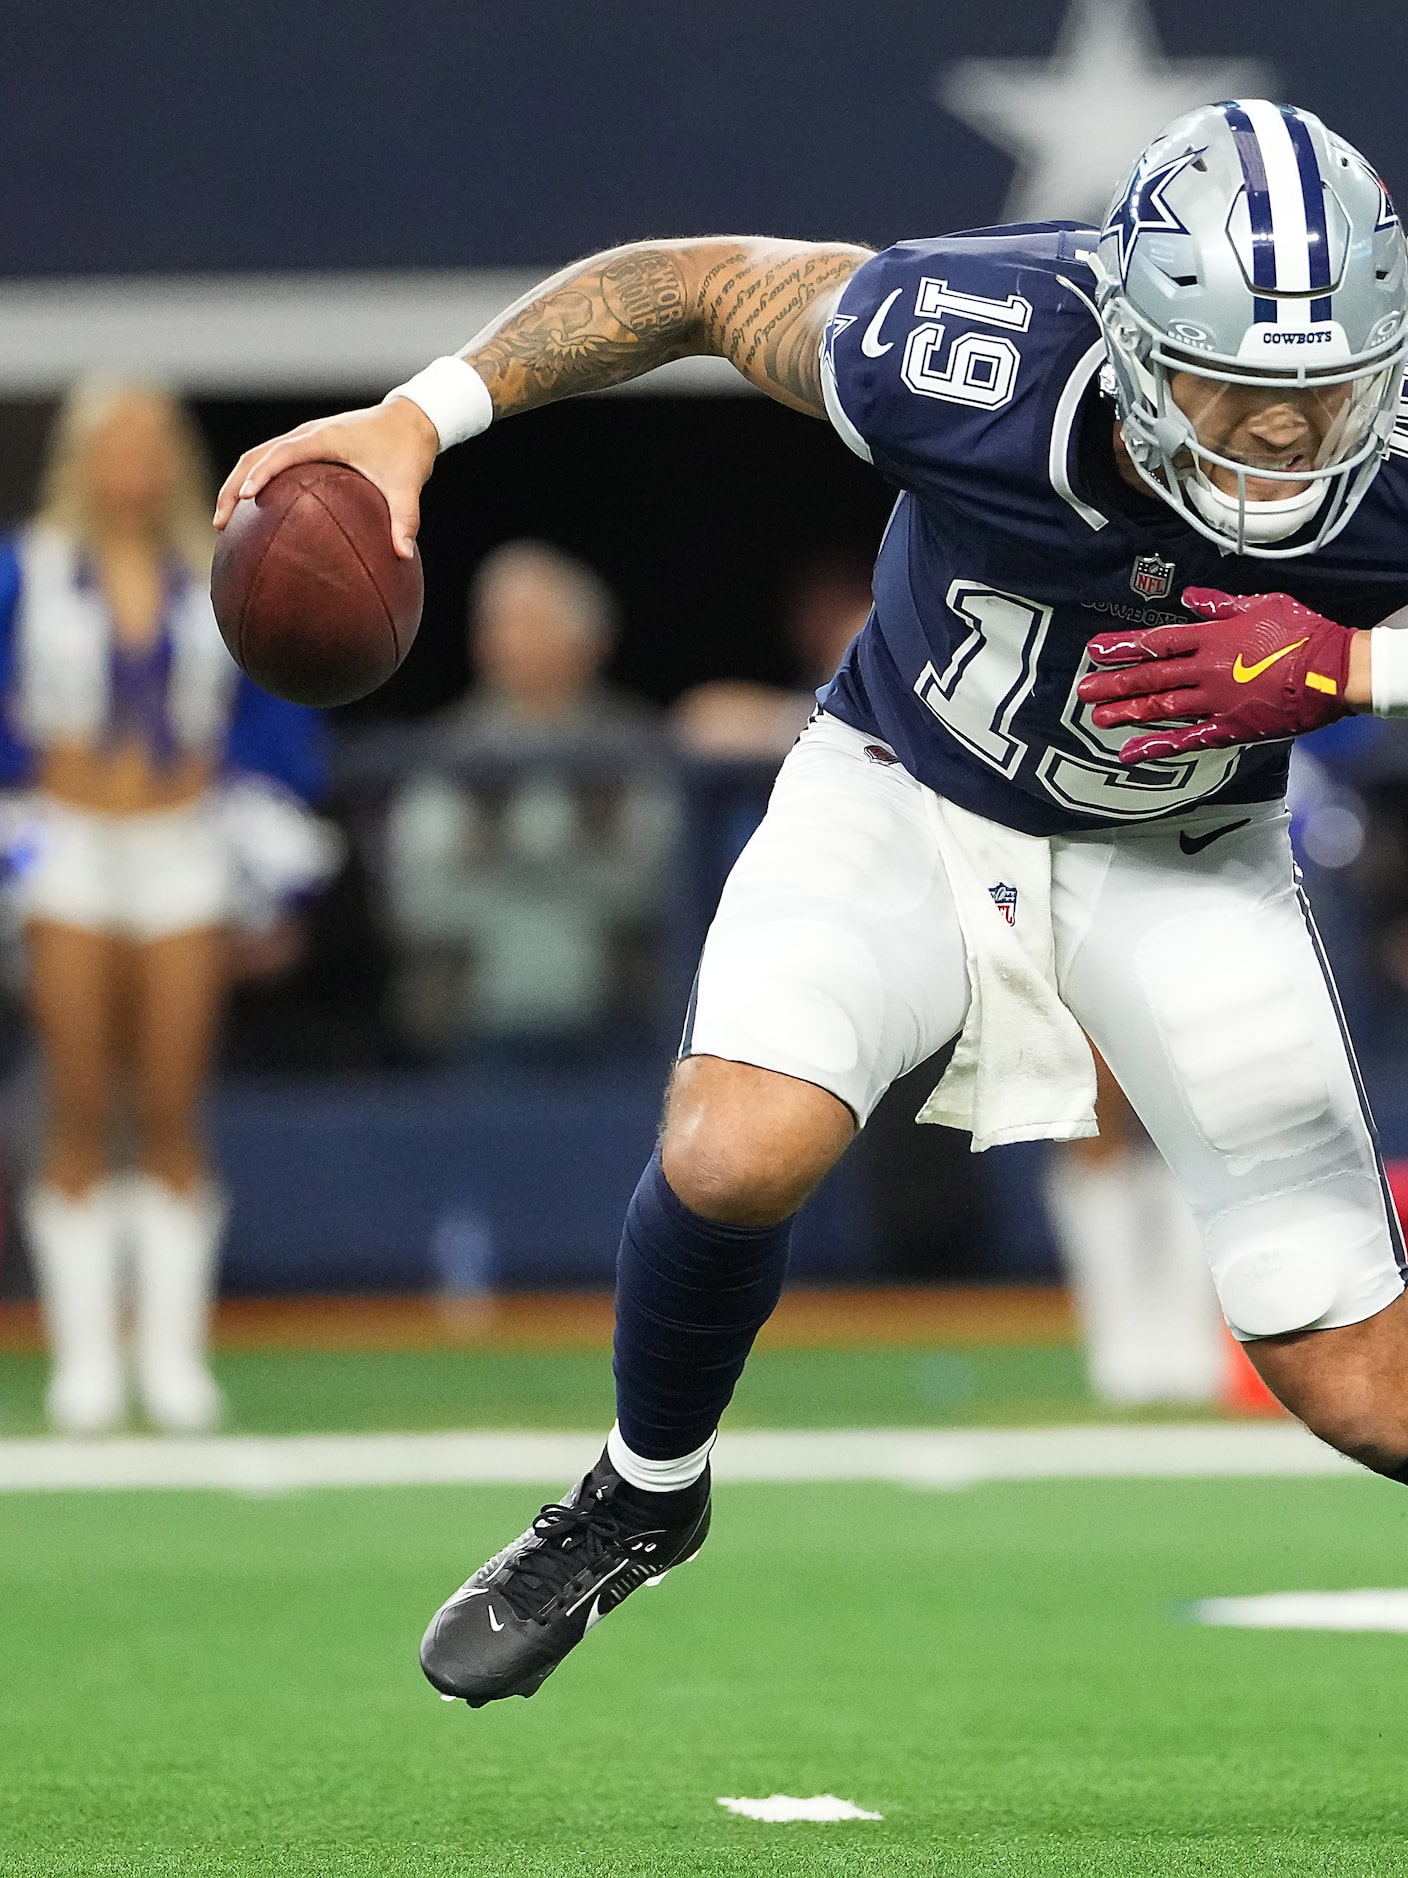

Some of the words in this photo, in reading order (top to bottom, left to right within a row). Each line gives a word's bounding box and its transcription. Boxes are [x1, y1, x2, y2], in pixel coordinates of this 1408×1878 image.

[900, 276, 1034, 412] 19
[1262, 330, 1333, 345] COWBOYS
[1137, 573, 1166, 594] NFL
